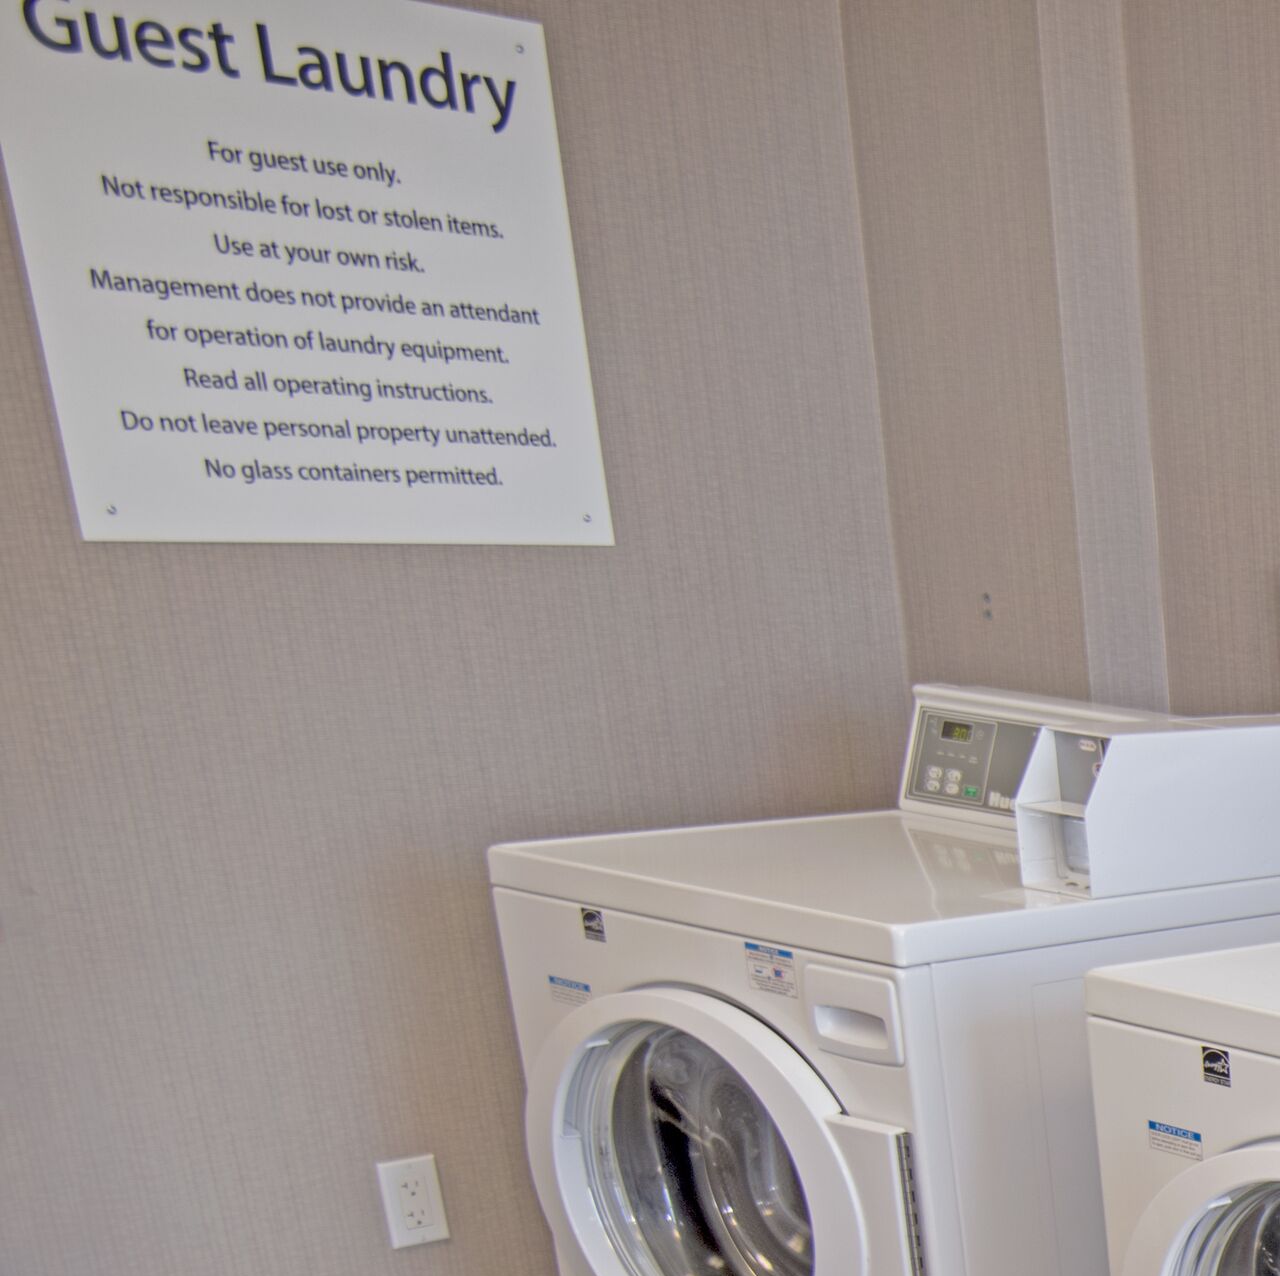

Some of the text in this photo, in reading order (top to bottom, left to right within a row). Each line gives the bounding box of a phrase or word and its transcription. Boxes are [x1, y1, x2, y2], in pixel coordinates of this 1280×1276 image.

[22, 0, 516, 134] Guest Laundry
[207, 140, 401, 188] For guest use only.
[101, 174, 503, 238] Not responsible for lost or stolen items.
[213, 233, 425, 273] Use at your own risk.
[90, 268, 540, 325] Management does not provide an attendant
[146, 319, 509, 364] for operation of laundry equipment.
[183, 368, 493, 403] Read all operating instructions.
[120, 410, 556, 447] Do not leave personal property unattended.
[204, 458, 503, 488] No glass containers permitted.
[1155, 1123, 1195, 1140] NOTICE
